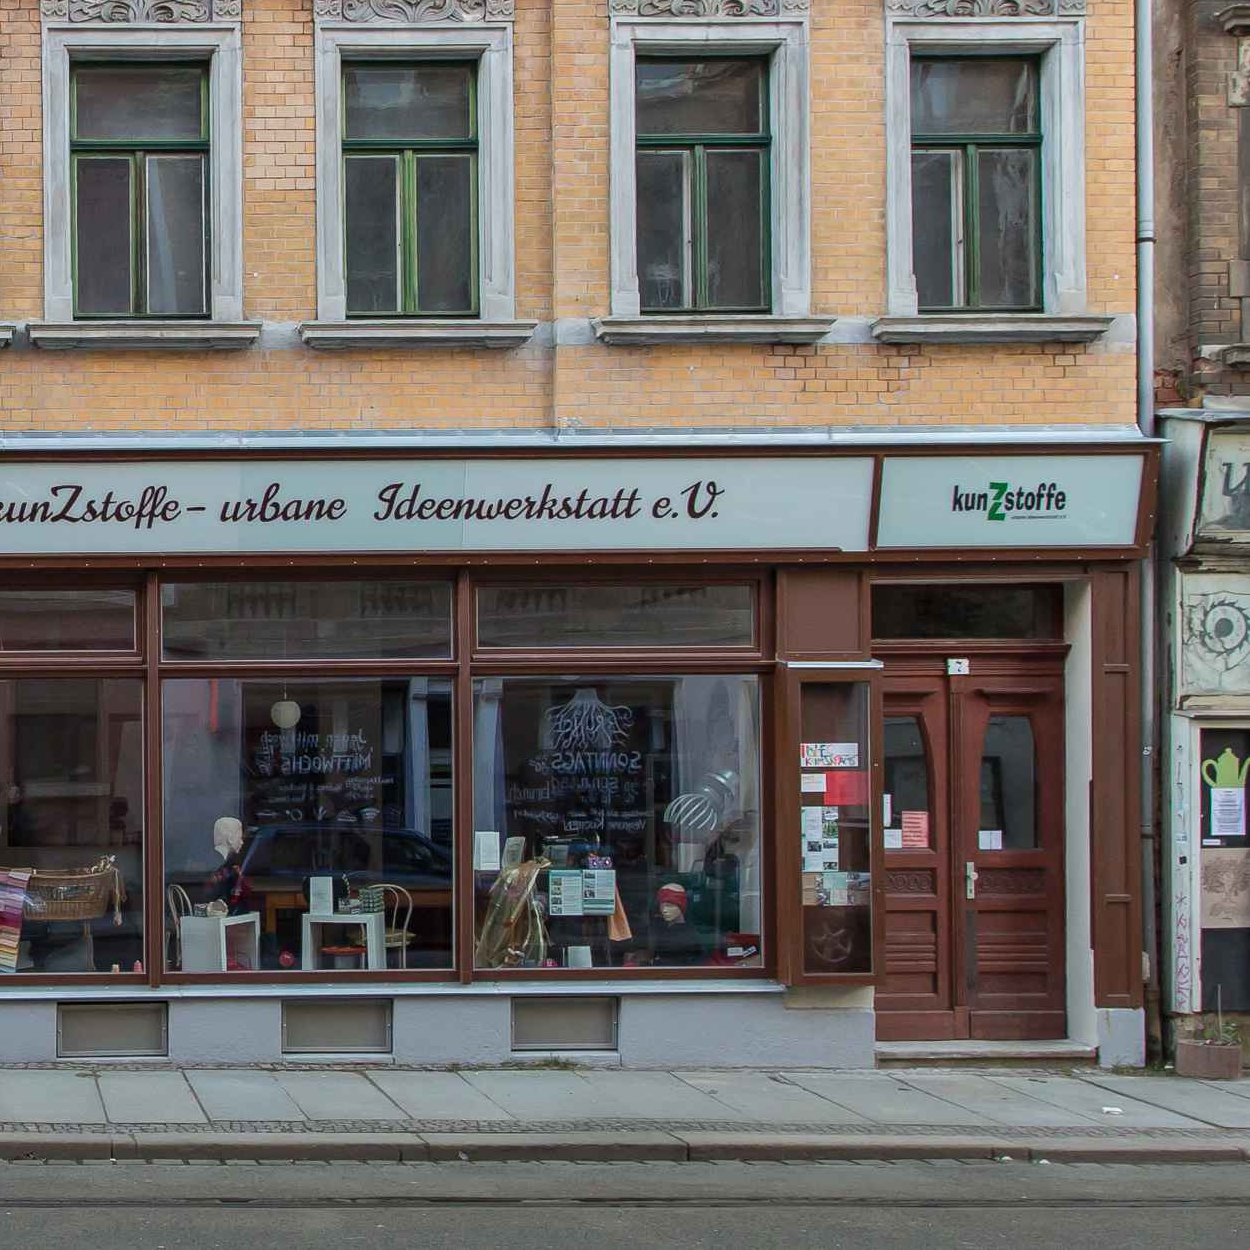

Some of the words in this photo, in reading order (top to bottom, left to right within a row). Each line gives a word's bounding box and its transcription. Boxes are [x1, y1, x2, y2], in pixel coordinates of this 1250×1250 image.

[219, 483, 348, 523] urbane
[374, 482, 642, 521] Ideenwerkstatt
[950, 481, 1067, 521] kunZstoffe
